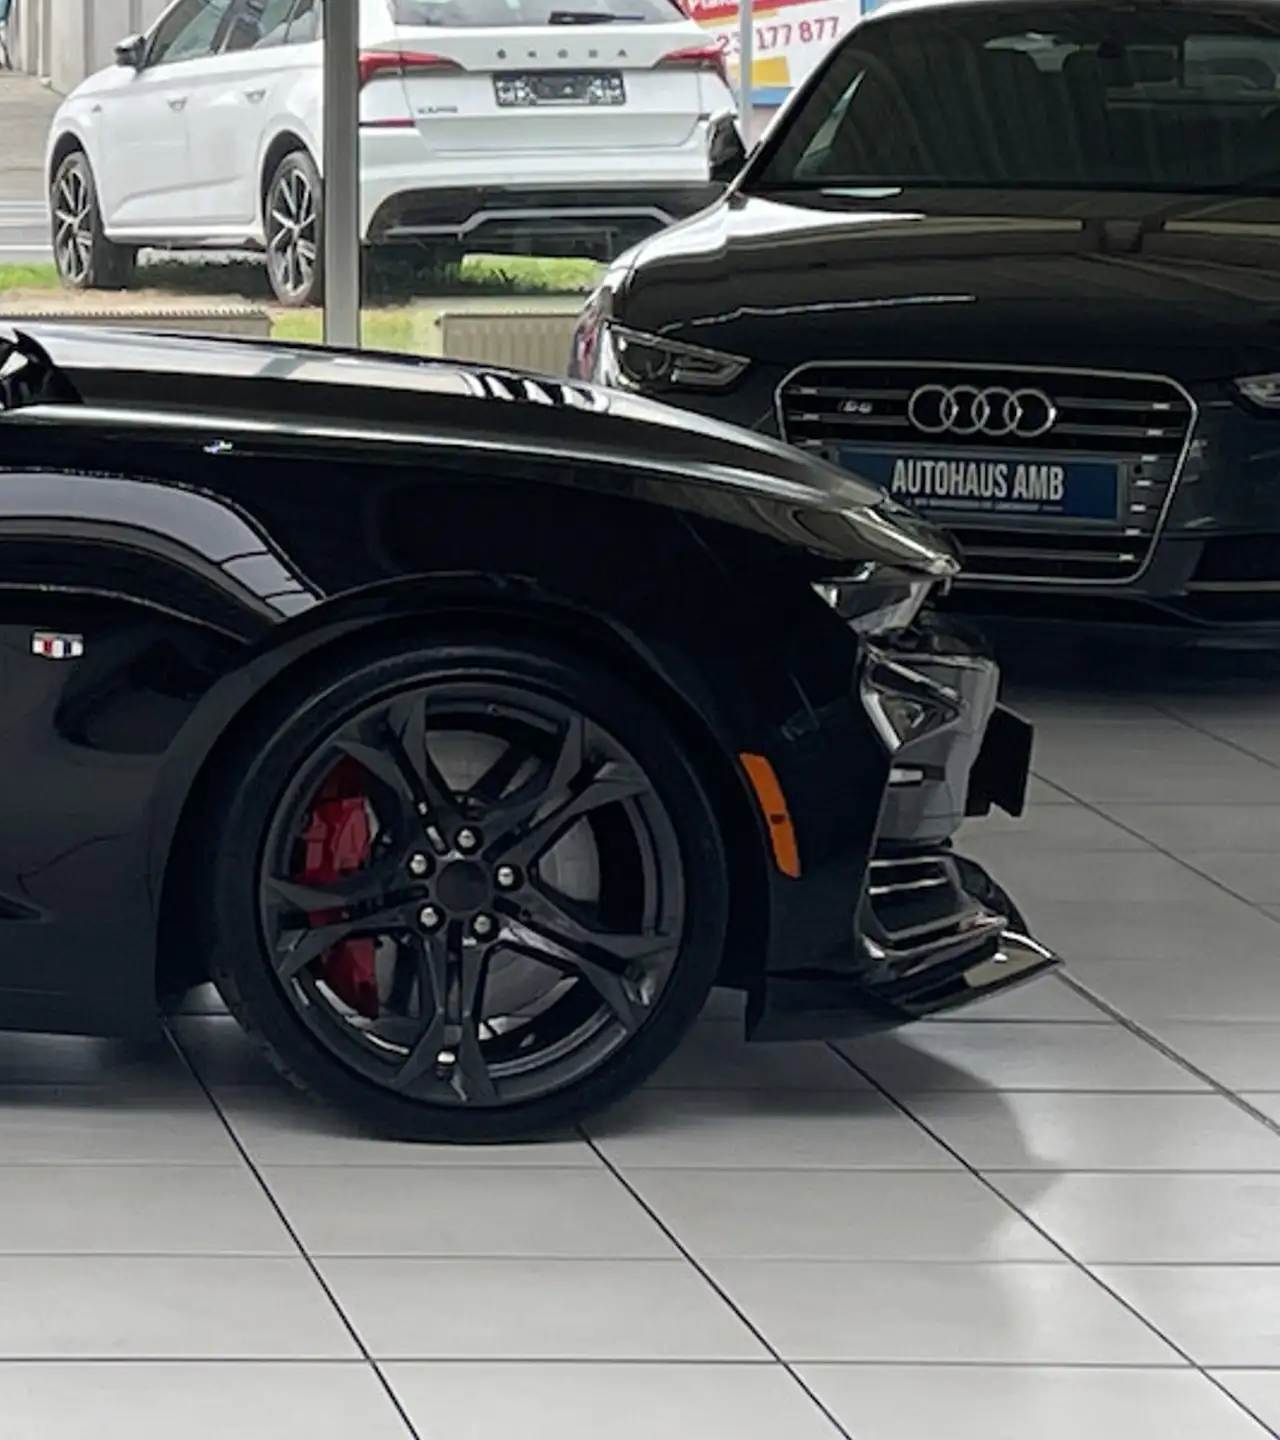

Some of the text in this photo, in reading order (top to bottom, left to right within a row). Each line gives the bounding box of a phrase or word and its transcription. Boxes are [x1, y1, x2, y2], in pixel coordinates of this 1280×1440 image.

[799, 16, 839, 43] 877
[892, 459, 1065, 501] AUTOHAUS AMB
